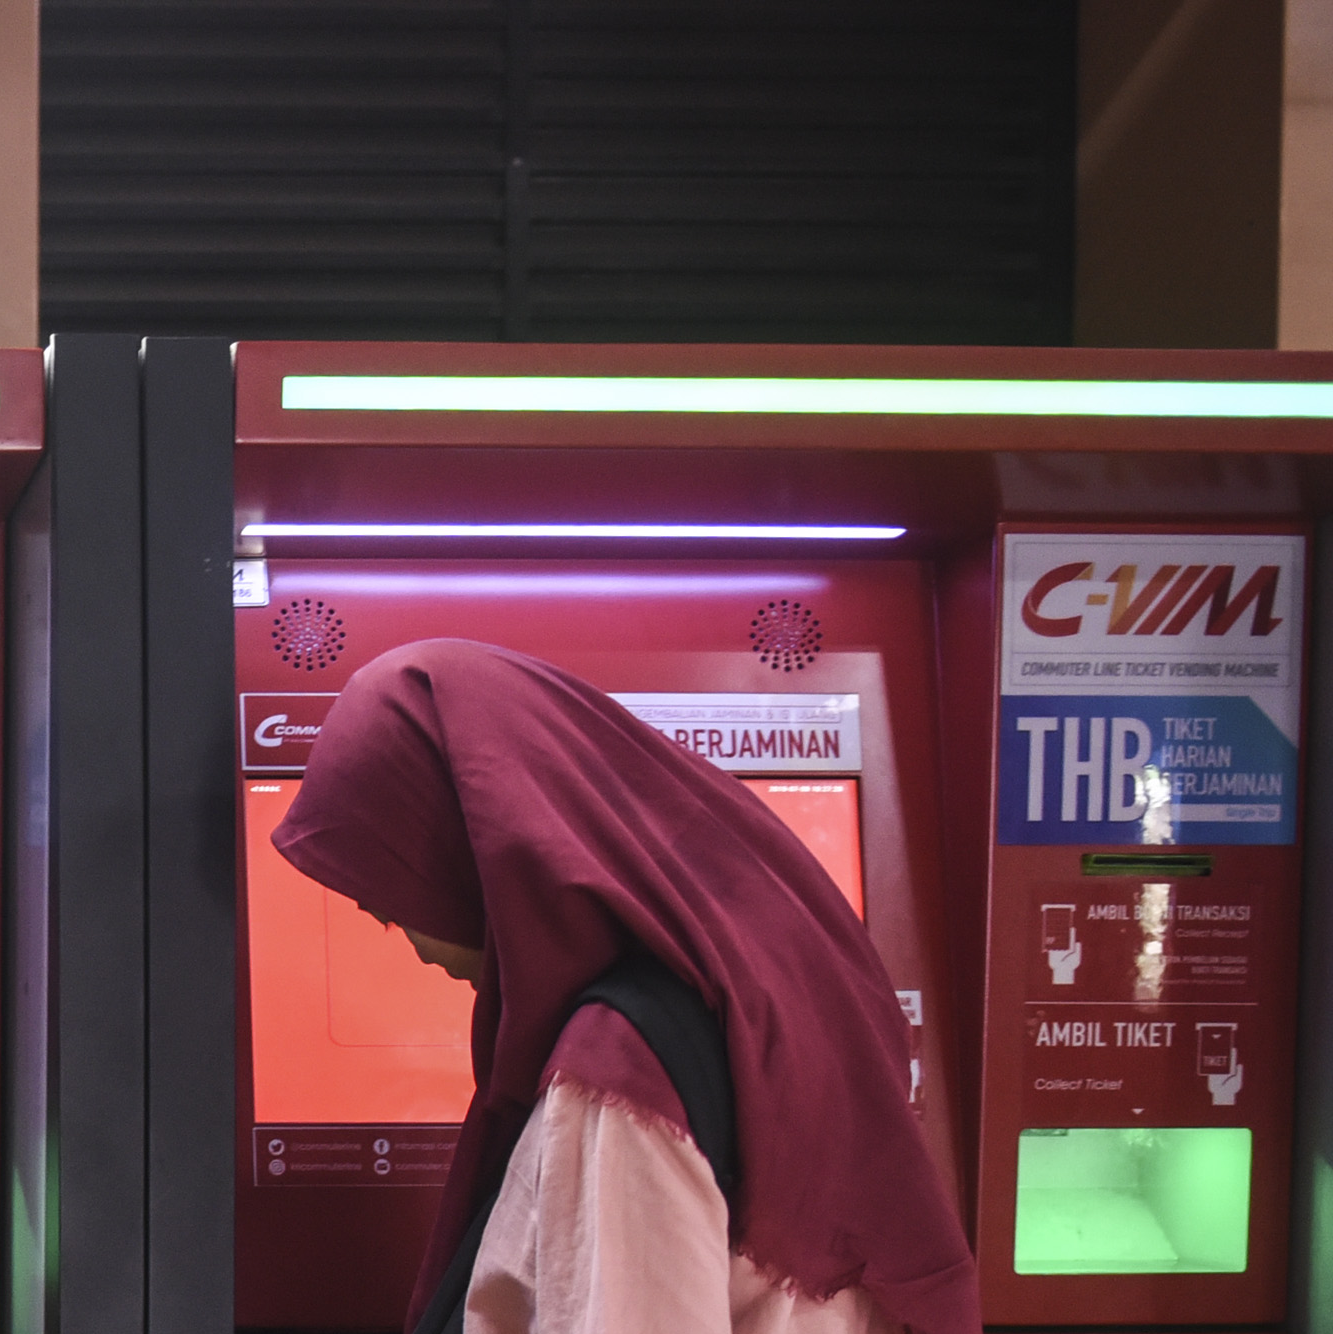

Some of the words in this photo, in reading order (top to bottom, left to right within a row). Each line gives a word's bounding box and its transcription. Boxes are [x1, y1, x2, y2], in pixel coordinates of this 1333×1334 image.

[1021, 562, 1283, 637] C-VIM
[1021, 662, 1091, 678] COMMUTER
[1093, 662, 1122, 678] LINE
[1124, 662, 1167, 678] TICKET
[1169, 662, 1221, 678] VENDING
[1224, 662, 1279, 678] MACHINE
[1162, 717, 1217, 740] TIKET
[676, 729, 840, 759] BERJAMINAN
[1161, 746, 1231, 768] HARIAN
[1016, 717, 1152, 822] THB
[1087, 905, 1130, 920] AMBIL
[1177, 905, 1251, 920] TRANSAKSI
[1036, 1023, 1107, 1048] AMBIL
[1113, 1023, 1176, 1048] TIKET
[1035, 1078, 1082, 1091] Collect
[1085, 1078, 1123, 1091] Ticket
